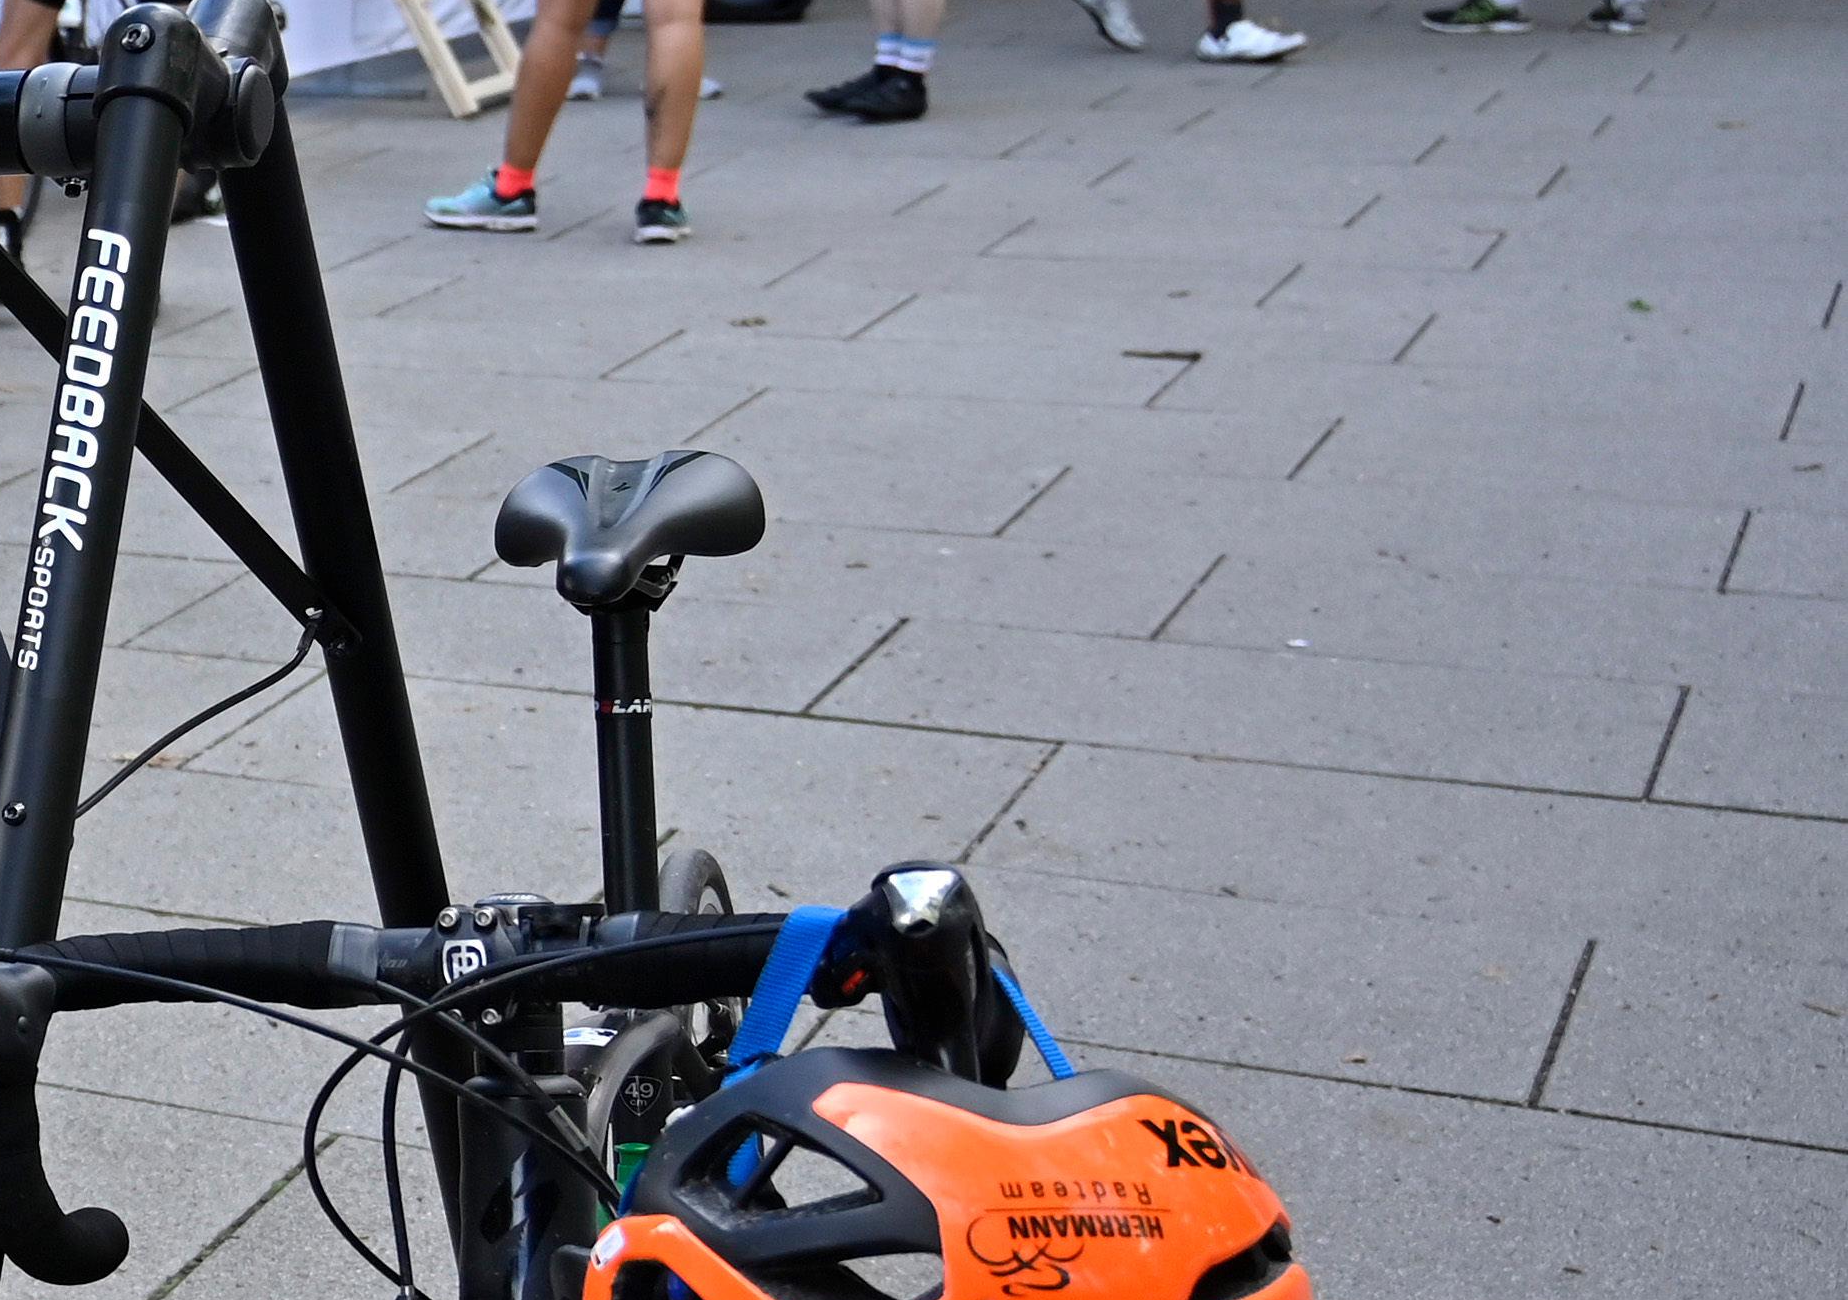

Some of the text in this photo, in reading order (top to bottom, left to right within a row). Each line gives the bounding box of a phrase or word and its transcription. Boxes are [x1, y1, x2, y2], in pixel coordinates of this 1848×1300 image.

[16, 227, 132, 672] FEEDBACK SPORTS
[624, 1082, 655, 1100] 49
[999, 1181, 1153, 1206] Radteam
[1007, 1214, 1165, 1240] HERRMANN
